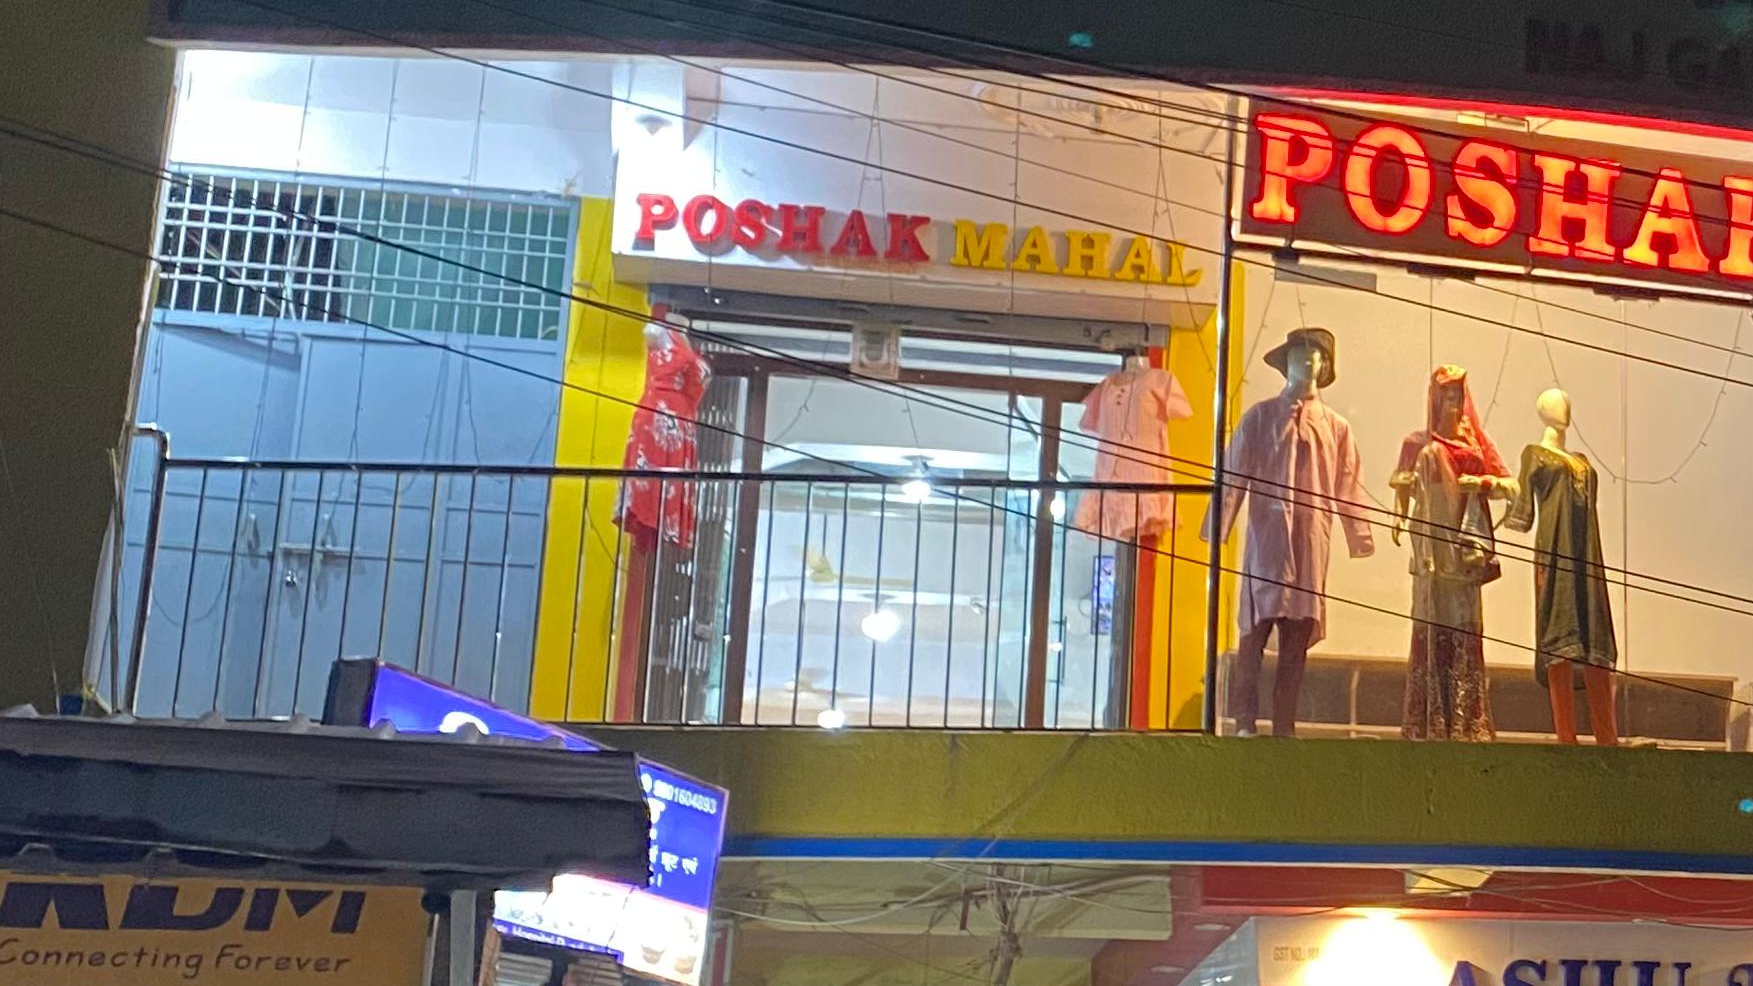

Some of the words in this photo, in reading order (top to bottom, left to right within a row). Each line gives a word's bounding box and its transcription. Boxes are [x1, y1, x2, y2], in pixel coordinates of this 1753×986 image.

[635, 192, 932, 264] POSHAK
[950, 218, 1204, 287] MAHAL
[0, 937, 202, 980] Connecting
[214, 943, 352, 975] Forever
